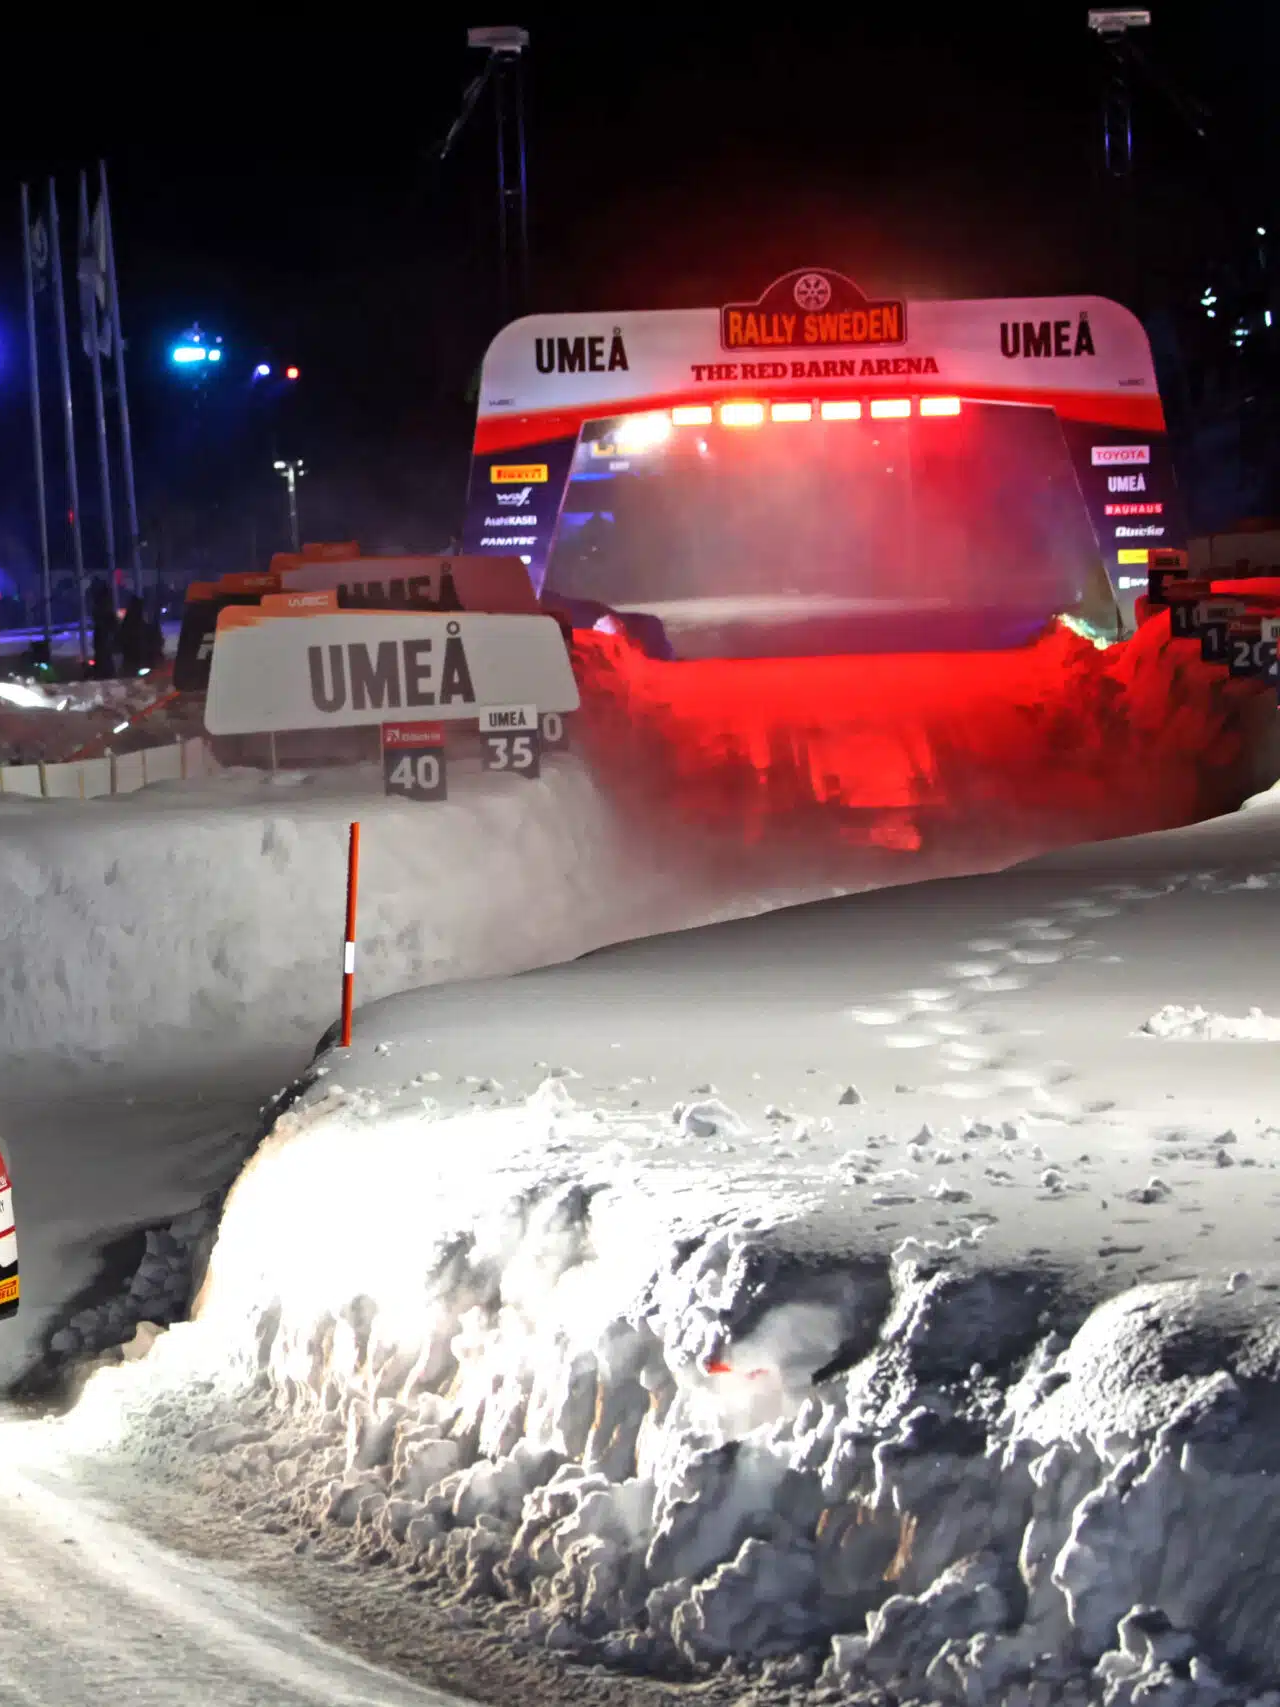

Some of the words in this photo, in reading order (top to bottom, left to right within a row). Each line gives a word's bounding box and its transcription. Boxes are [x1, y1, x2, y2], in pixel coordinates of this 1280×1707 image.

[729, 311, 796, 345] RALLY
[804, 304, 900, 343] SWEDEN
[1000, 311, 1095, 358] UMEÅ
[535, 327, 629, 374] UMEÅ
[691, 364, 737, 381] THE
[741, 362, 787, 379] RED
[790, 360, 854, 378] BARN
[859, 356, 940, 376] ARENA
[1095, 450, 1146, 462] TOYOTA
[1107, 472, 1146, 493] UMEÅ
[1105, 503, 1163, 516] BAUHAUS
[308, 620, 476, 713] UMEÅ
[488, 710, 528, 727] UMEÅ
[488, 736, 533, 770] 35
[389, 754, 440, 790] 40
